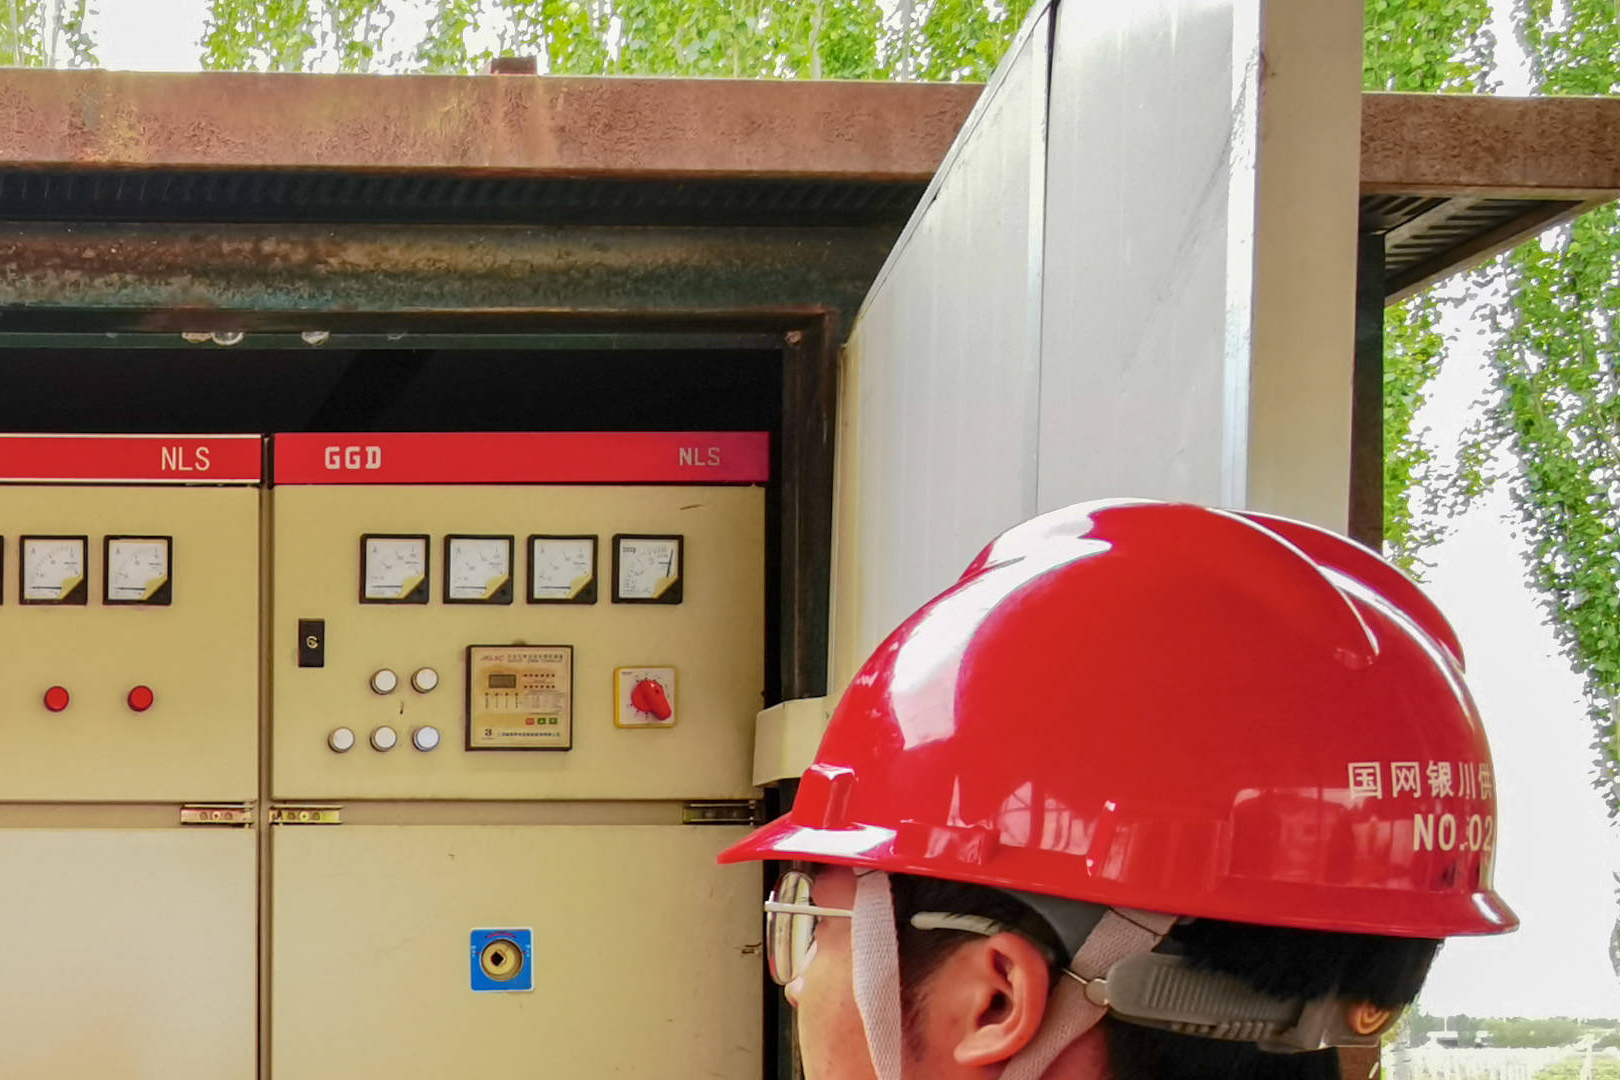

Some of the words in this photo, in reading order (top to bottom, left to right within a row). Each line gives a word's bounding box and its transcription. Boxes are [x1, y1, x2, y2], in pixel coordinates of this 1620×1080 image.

[161, 446, 210, 471] NLS
[324, 445, 382, 470] GGD
[679, 447, 720, 466] NLS
